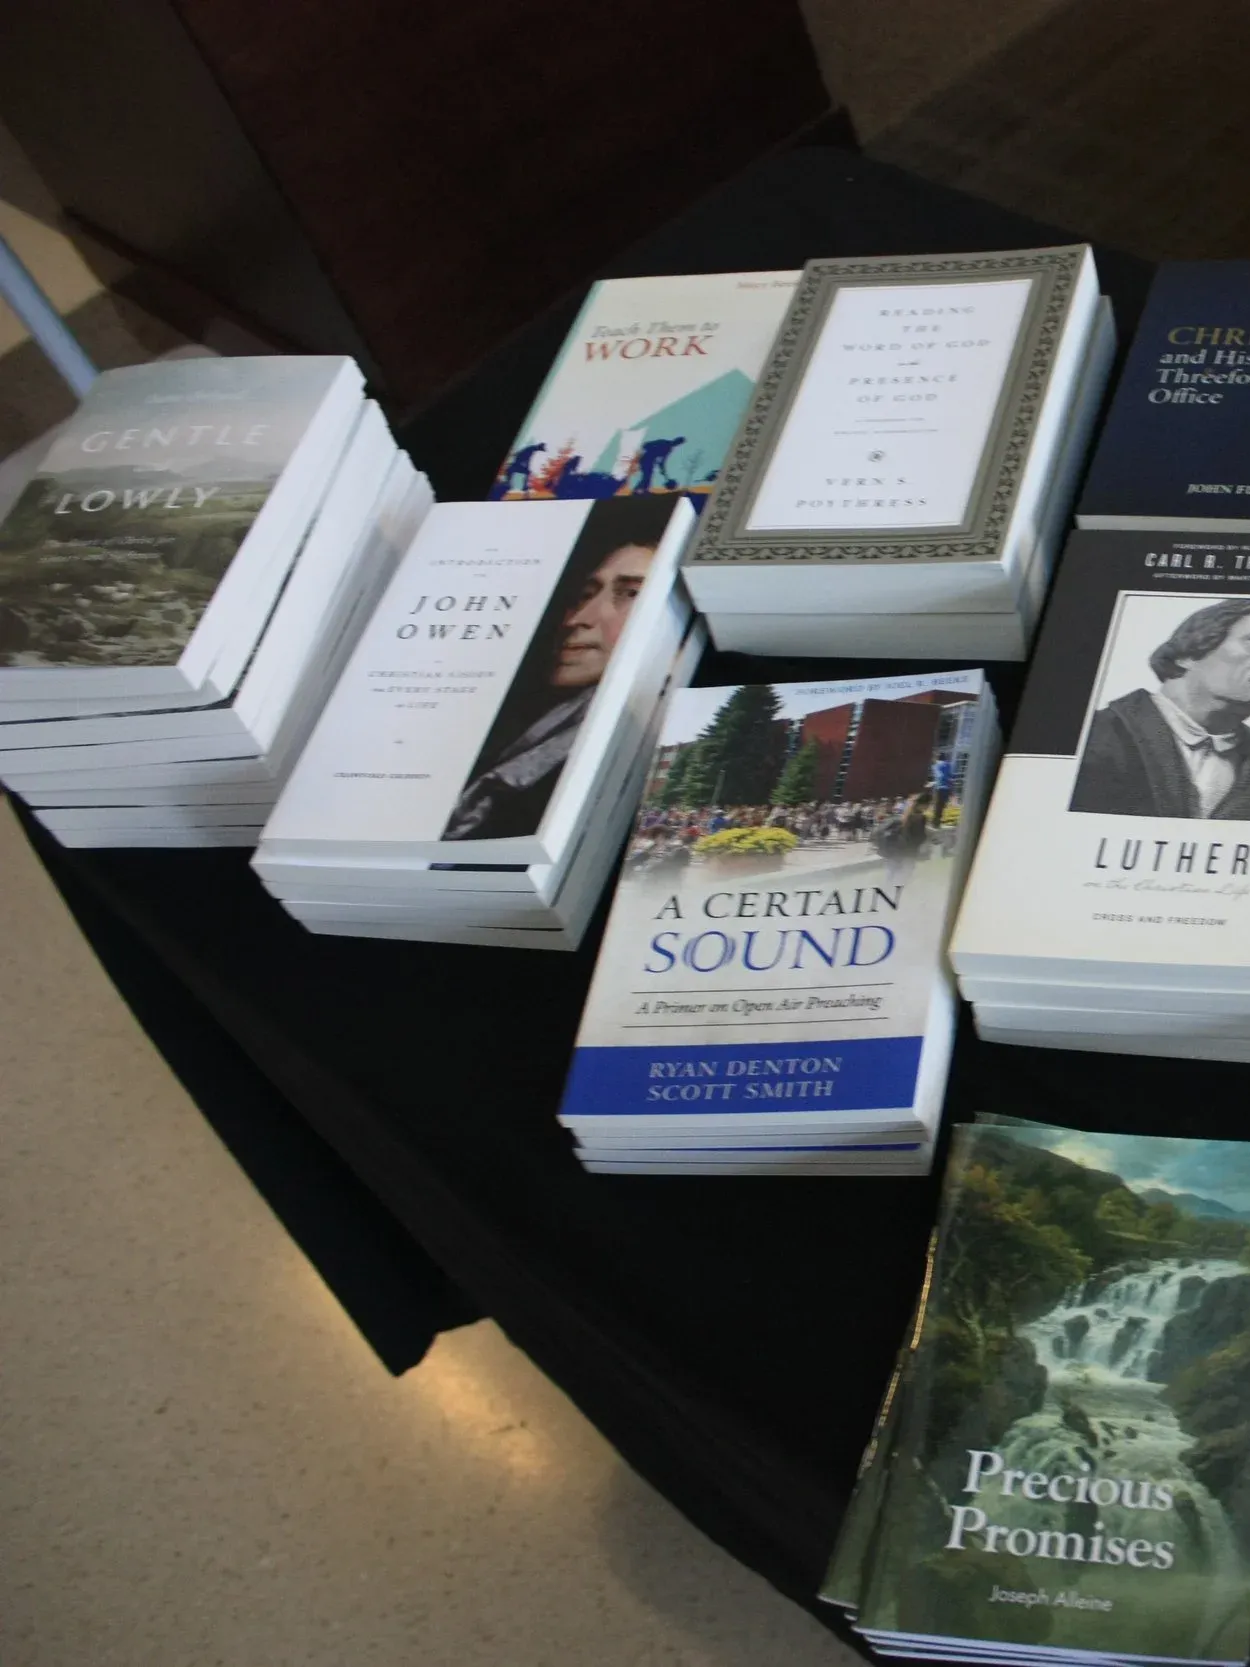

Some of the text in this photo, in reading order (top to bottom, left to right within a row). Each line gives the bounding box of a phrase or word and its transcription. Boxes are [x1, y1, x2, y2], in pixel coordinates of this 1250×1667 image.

[584, 335, 714, 363] WORK
[1159, 348, 1206, 366] and
[848, 374, 959, 385] PRESENCE
[1147, 387, 1225, 405] Office
[81, 423, 270, 453] GENTLE
[53, 486, 221, 515] LOWLY
[1186, 484, 1234, 496] JOHN
[1144, 552, 1193, 568] CARL
[1203, 554, 1224, 569] R.
[410, 595, 519, 615] JOHN
[396, 623, 511, 641] OWEN
[652, 884, 905, 920] A CERTAIN
[643, 924, 896, 975] SOUND
[634, 995, 884, 1016] A Primer on Open Air Preaching
[648, 1056, 844, 1078] RYAN DENTON
[646, 1080, 836, 1102] SCOTT SMITH
[961, 1448, 1175, 1513] Precious
[943, 1504, 1175, 1571] Promises
[989, 1584, 1113, 1613] Joseph Alleine
